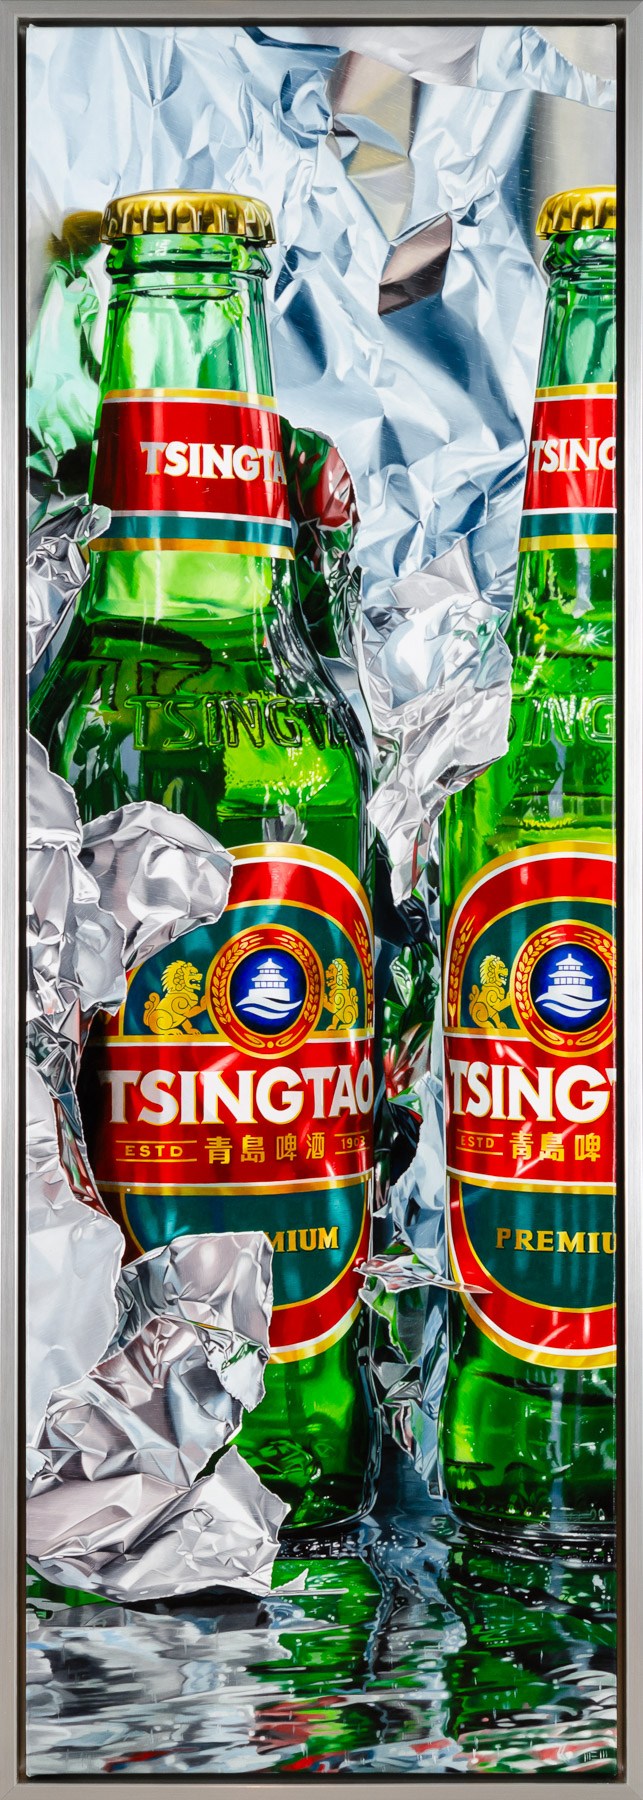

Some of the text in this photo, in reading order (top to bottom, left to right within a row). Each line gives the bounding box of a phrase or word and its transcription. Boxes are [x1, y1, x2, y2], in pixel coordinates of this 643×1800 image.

[98, 1060, 374, 1126] TSINGTAO
[449, 1059, 616, 1124] TSING
[125, 1145, 184, 1157] ESTD
[204, 1132, 326, 1165] 青島啤酒
[341, 1135, 366, 1150] 1903
[460, 1135, 495, 1149] ESTD
